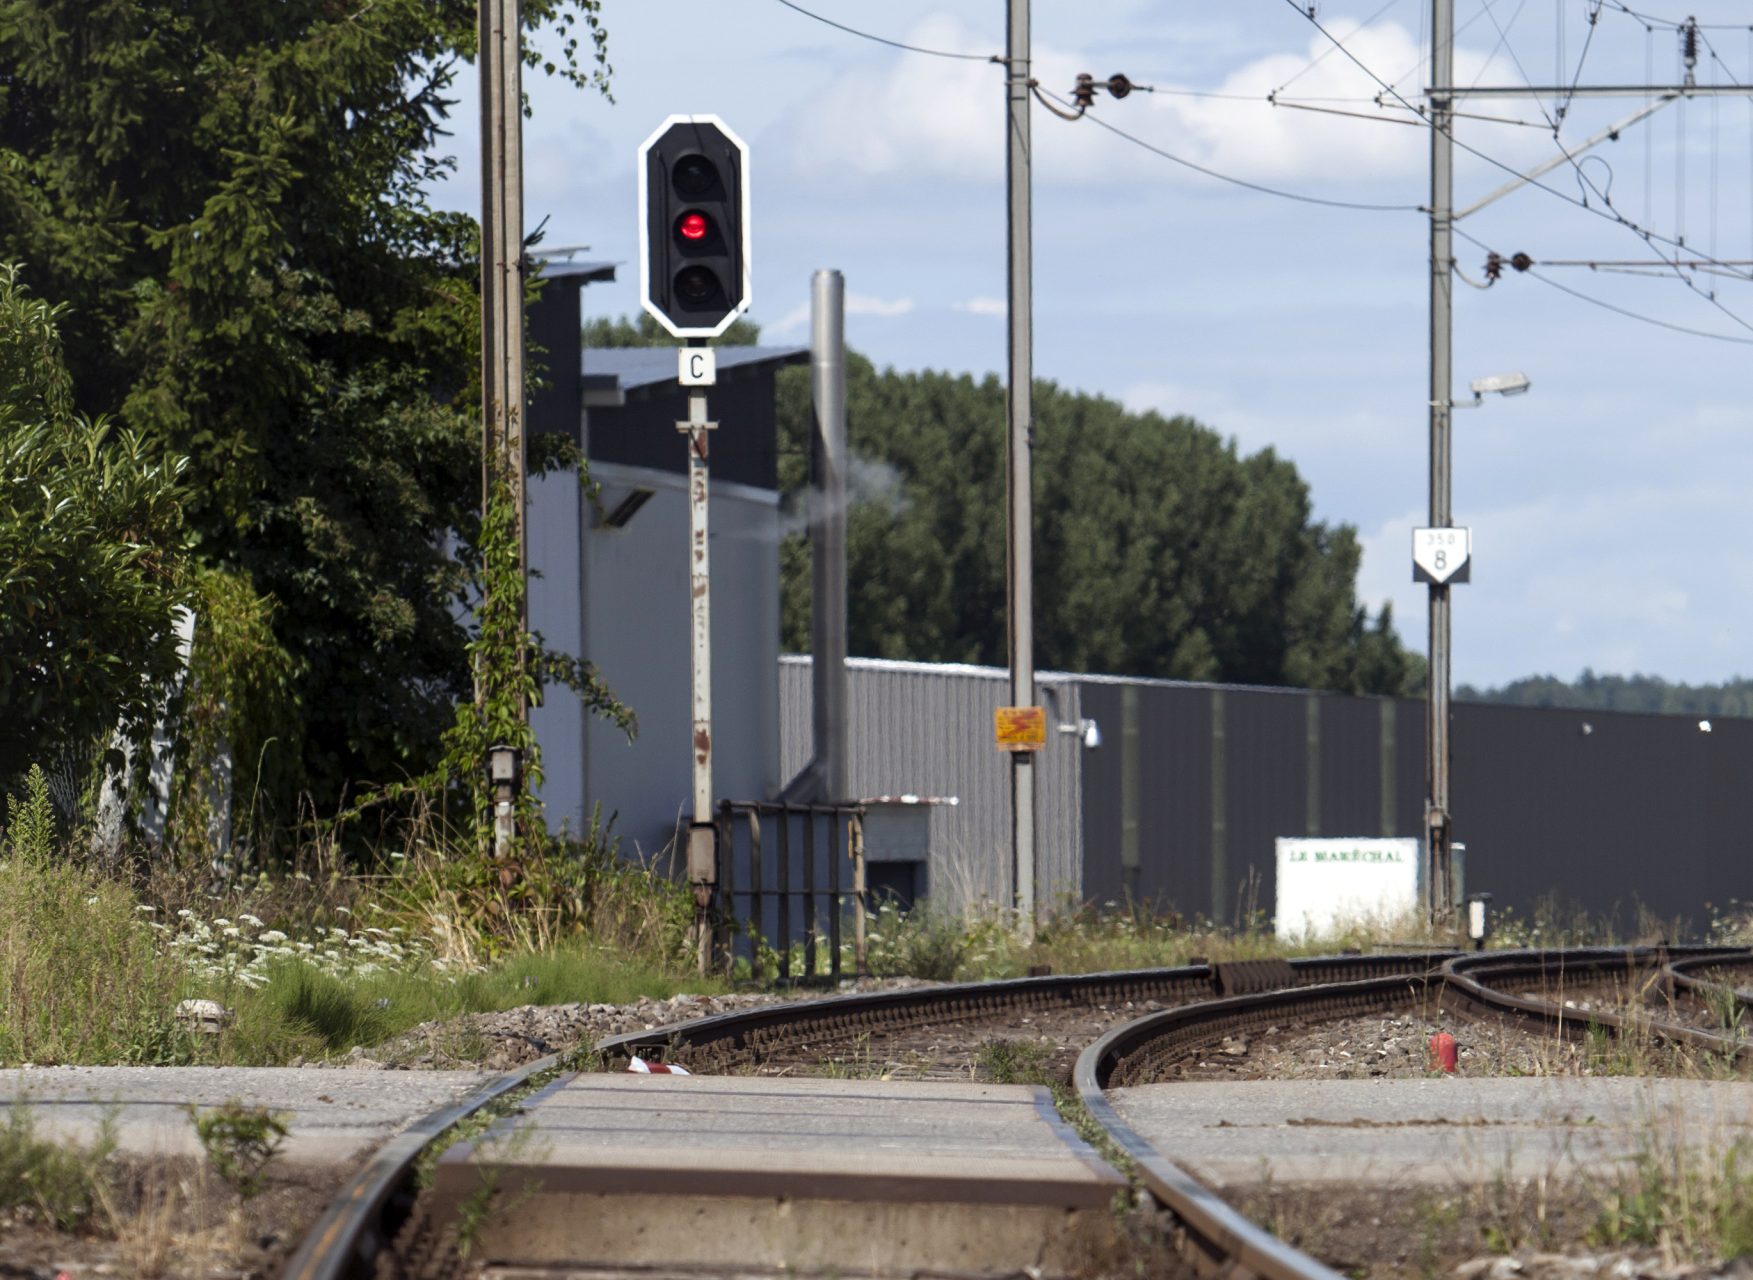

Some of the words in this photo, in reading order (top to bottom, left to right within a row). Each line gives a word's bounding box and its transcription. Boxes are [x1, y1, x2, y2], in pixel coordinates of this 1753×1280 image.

[690, 354, 704, 379] C
[1434, 549, 1447, 571] 8
[1289, 850, 1308, 862] LE
[1314, 848, 1404, 863] MARÉCHAL
